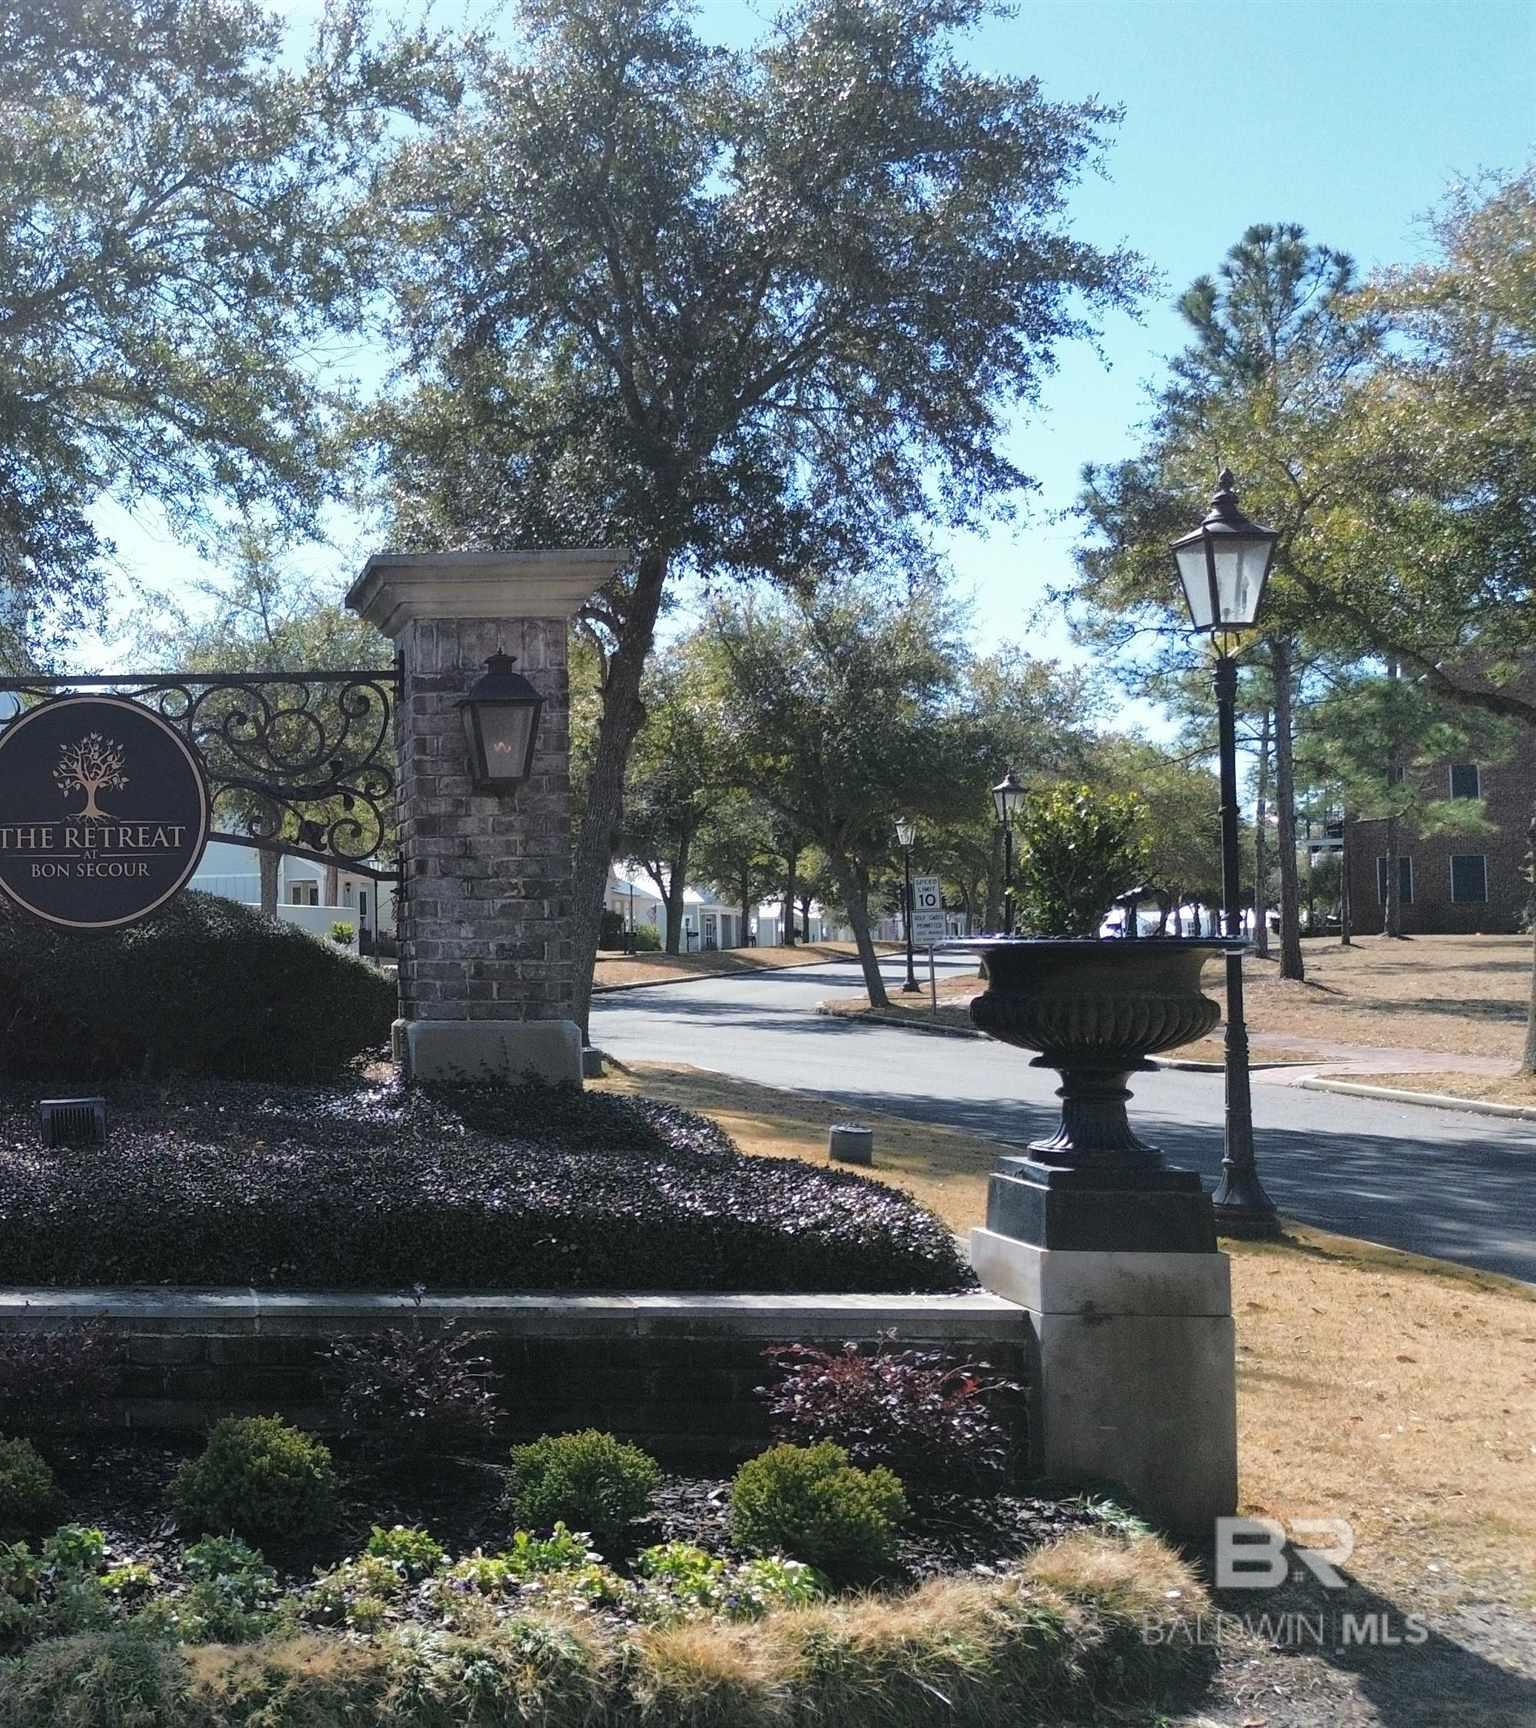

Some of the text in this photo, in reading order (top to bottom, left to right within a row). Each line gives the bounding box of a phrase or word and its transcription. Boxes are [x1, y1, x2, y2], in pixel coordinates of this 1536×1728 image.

[65, 826, 186, 848] RETREAT
[83, 850, 99, 859] AT
[31, 862, 150, 878] BON SECOUR
[919, 894, 936, 906] 10
